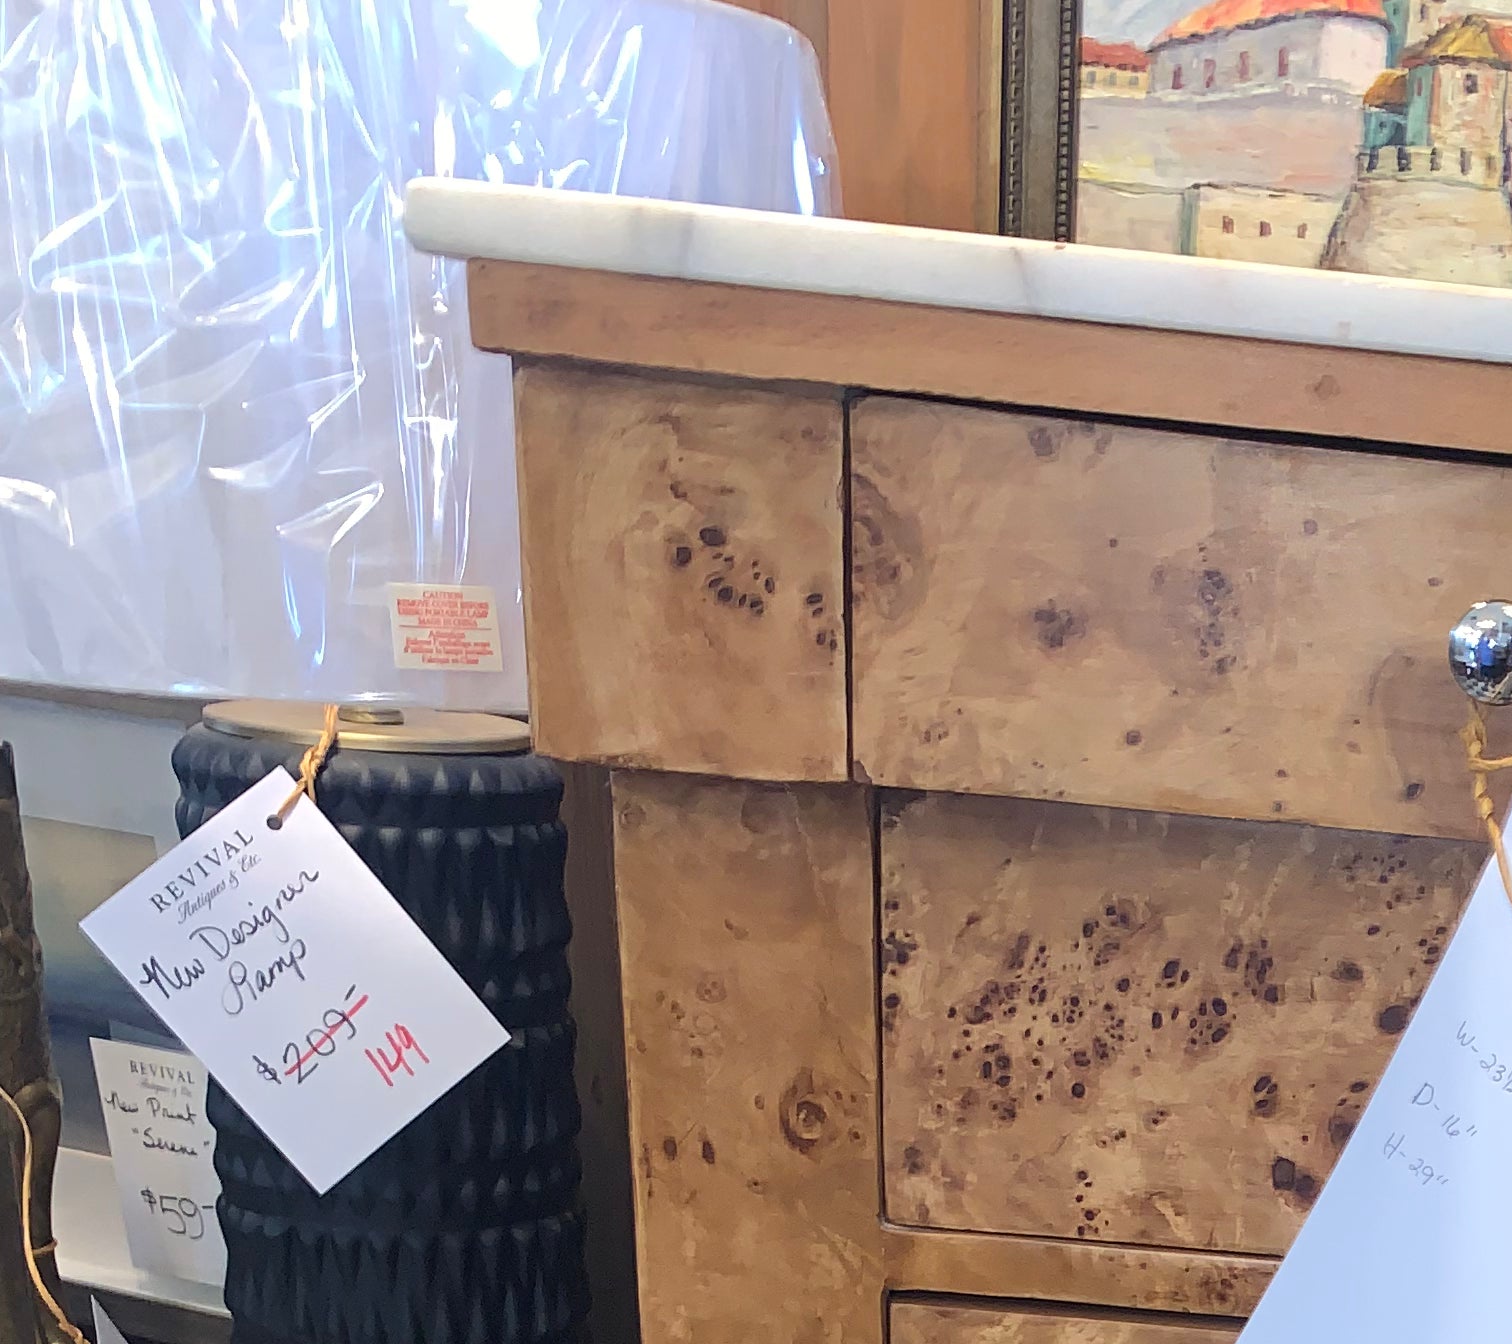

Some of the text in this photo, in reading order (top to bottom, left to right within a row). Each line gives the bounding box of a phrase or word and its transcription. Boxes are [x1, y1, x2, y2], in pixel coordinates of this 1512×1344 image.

[148, 829, 254, 914] REVIVAL
[177, 877, 227, 925] Antiques
[229, 870, 240, 889] &
[139, 870, 321, 999] New Designer
[221, 938, 307, 1015] Lamp
[129, 1059, 196, 1085] REVIVAL
[363, 1022, 431, 1087] 149
